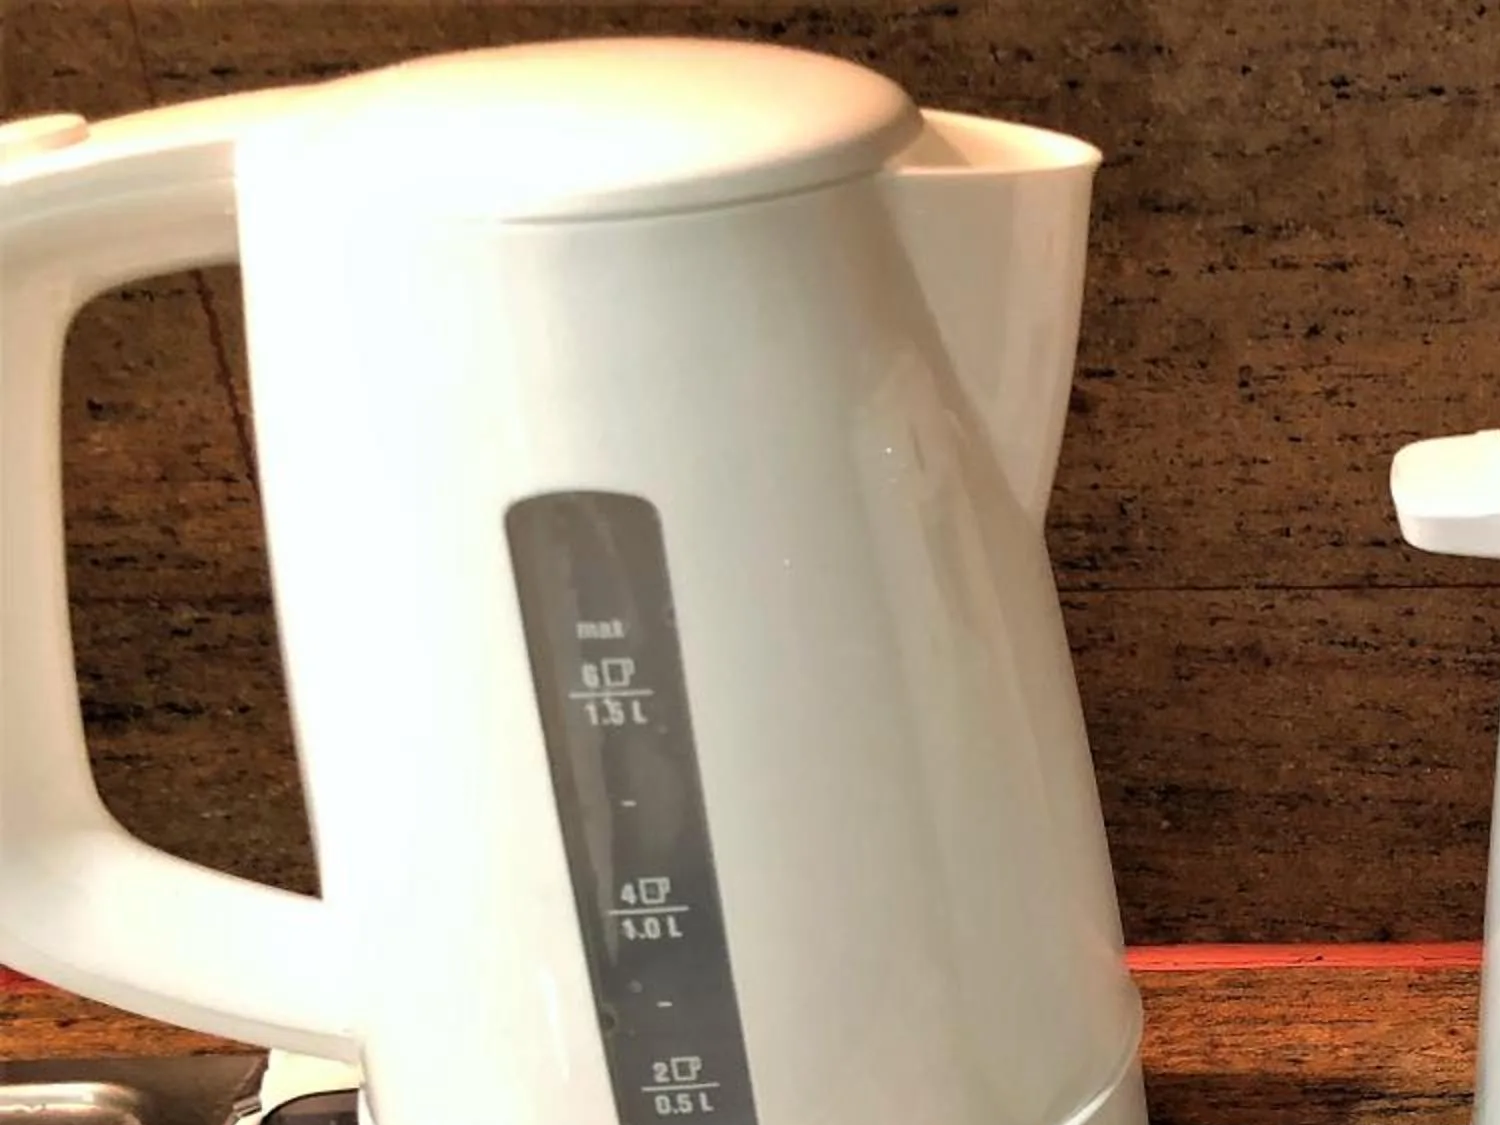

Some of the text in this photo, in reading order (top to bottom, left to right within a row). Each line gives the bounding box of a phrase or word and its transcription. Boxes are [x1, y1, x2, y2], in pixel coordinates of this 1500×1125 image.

[581, 662, 600, 688] 6
[584, 699, 648, 725] 1.5 L
[621, 883, 637, 905] 4
[622, 915, 683, 940] 1.0 L
[653, 1061, 670, 1083] 2
[655, 1092, 715, 1115] 0.5 L
